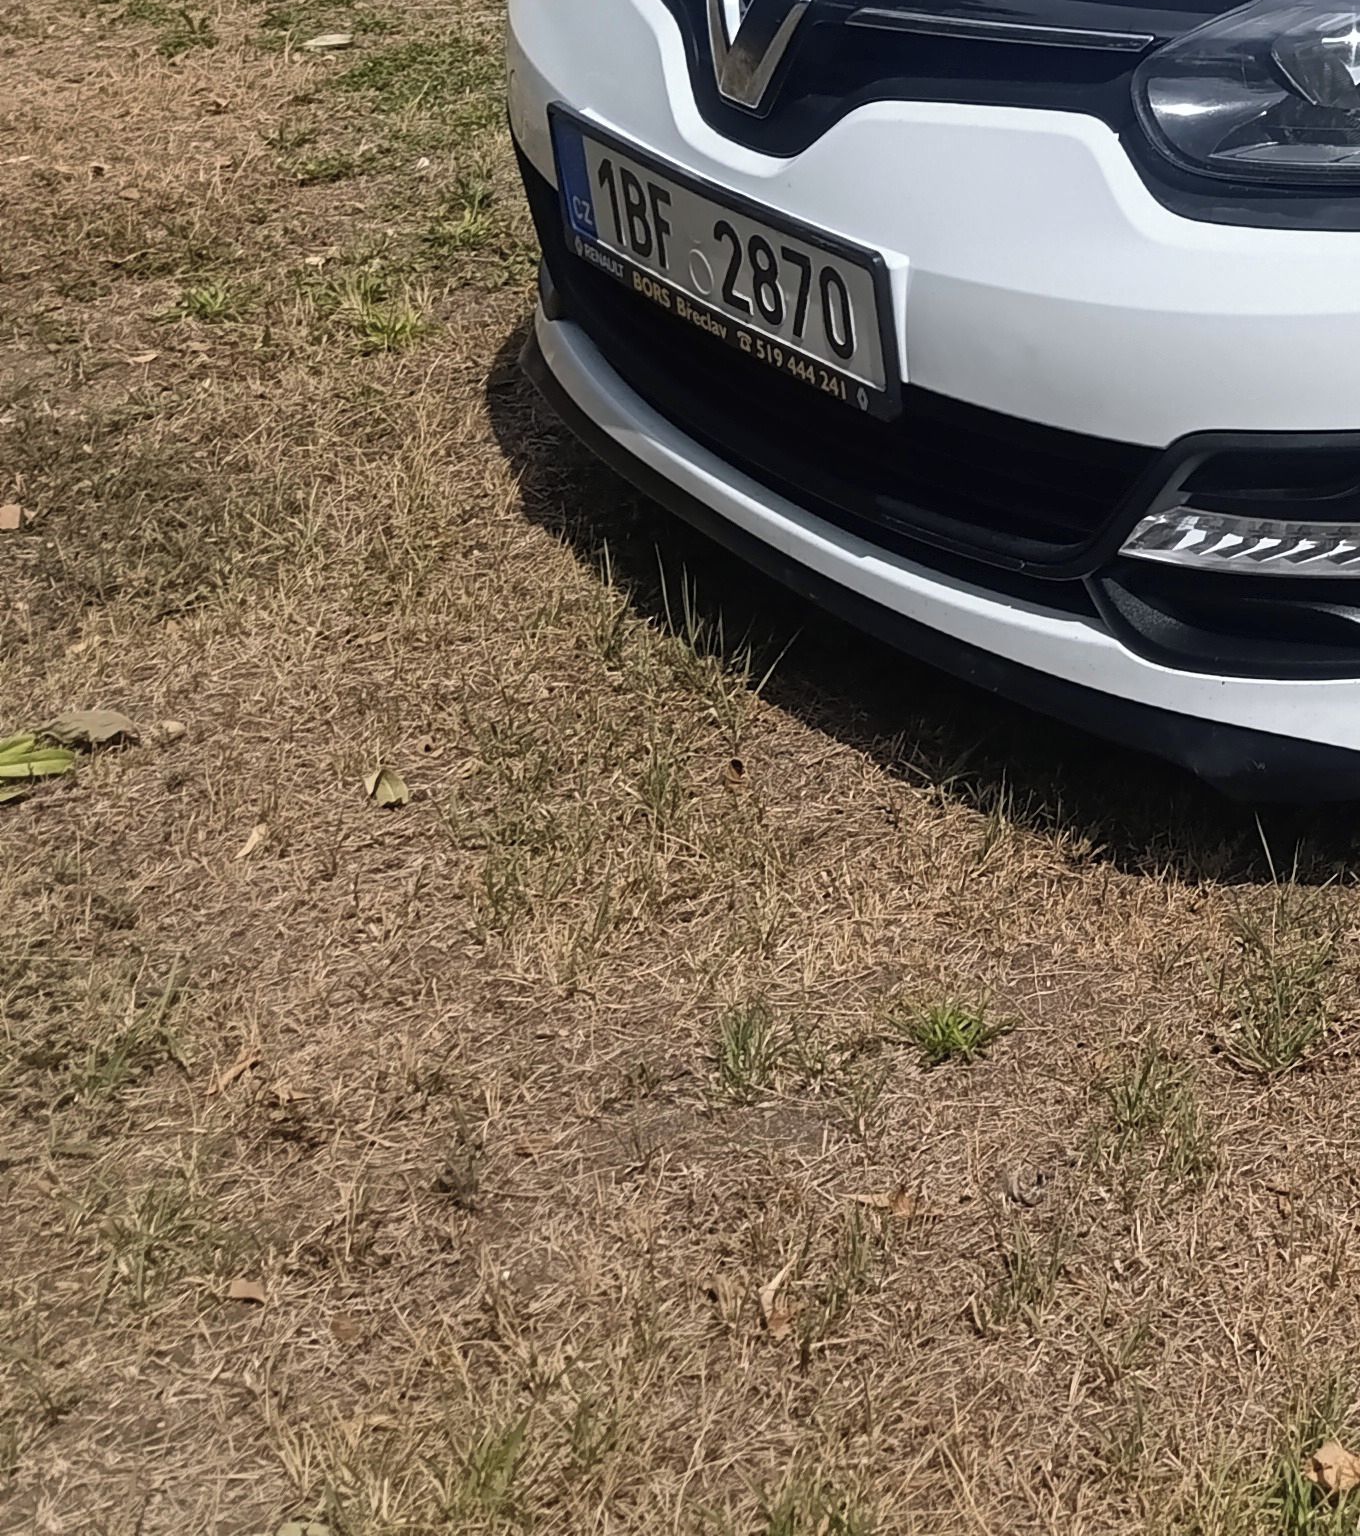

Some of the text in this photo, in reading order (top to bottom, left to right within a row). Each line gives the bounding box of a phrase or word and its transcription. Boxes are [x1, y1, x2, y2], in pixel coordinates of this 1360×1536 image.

[572, 195, 593, 226] CZ
[584, 243, 624, 278] RENAULT
[598, 158, 855, 360] 1BF 2870
[632, 270, 847, 400] BORS Břeclav 519 444 241
